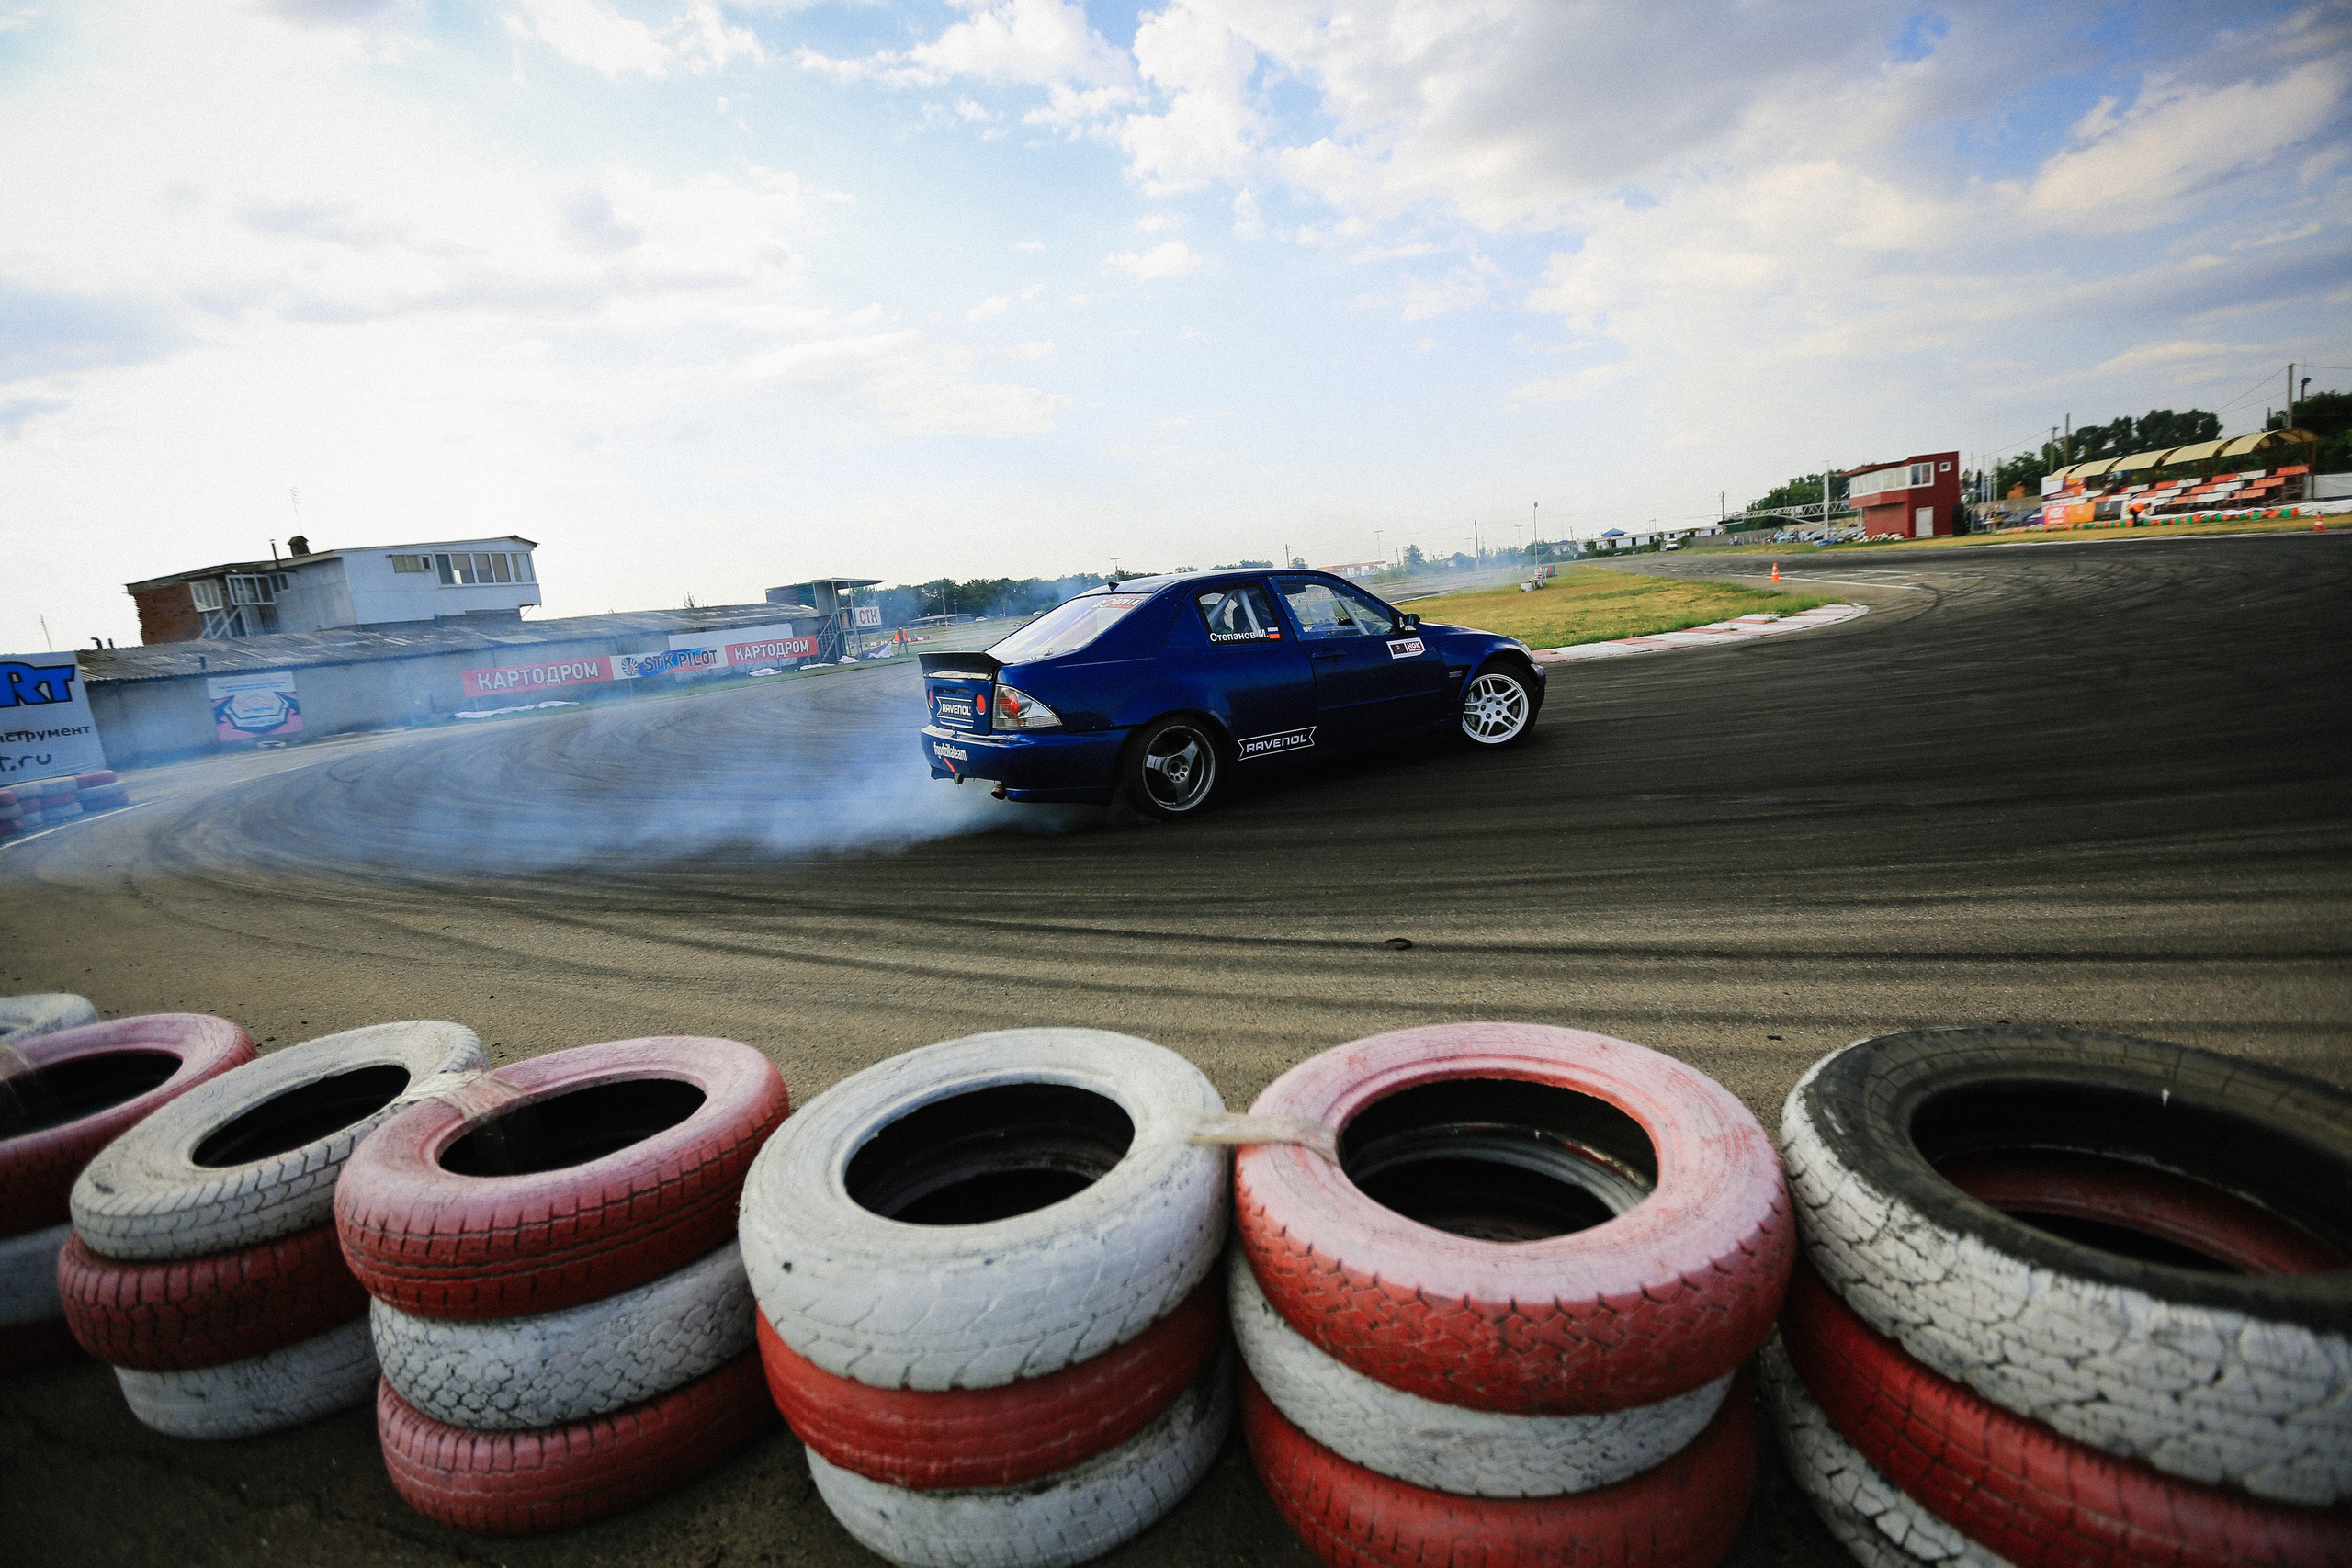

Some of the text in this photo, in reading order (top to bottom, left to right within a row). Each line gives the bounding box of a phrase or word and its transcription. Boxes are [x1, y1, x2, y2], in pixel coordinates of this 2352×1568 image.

[859, 608, 878, 625] СТК
[1209, 632, 1256, 642] Степанов
[734, 639, 809, 662] КАРТОДРОМ
[644, 649, 718, 672] STK PILOT
[477, 660, 599, 691] КАРТОДРОМ
[942, 703, 971, 716] RAVENOL
[1246, 734, 1307, 753] RAVENOL
